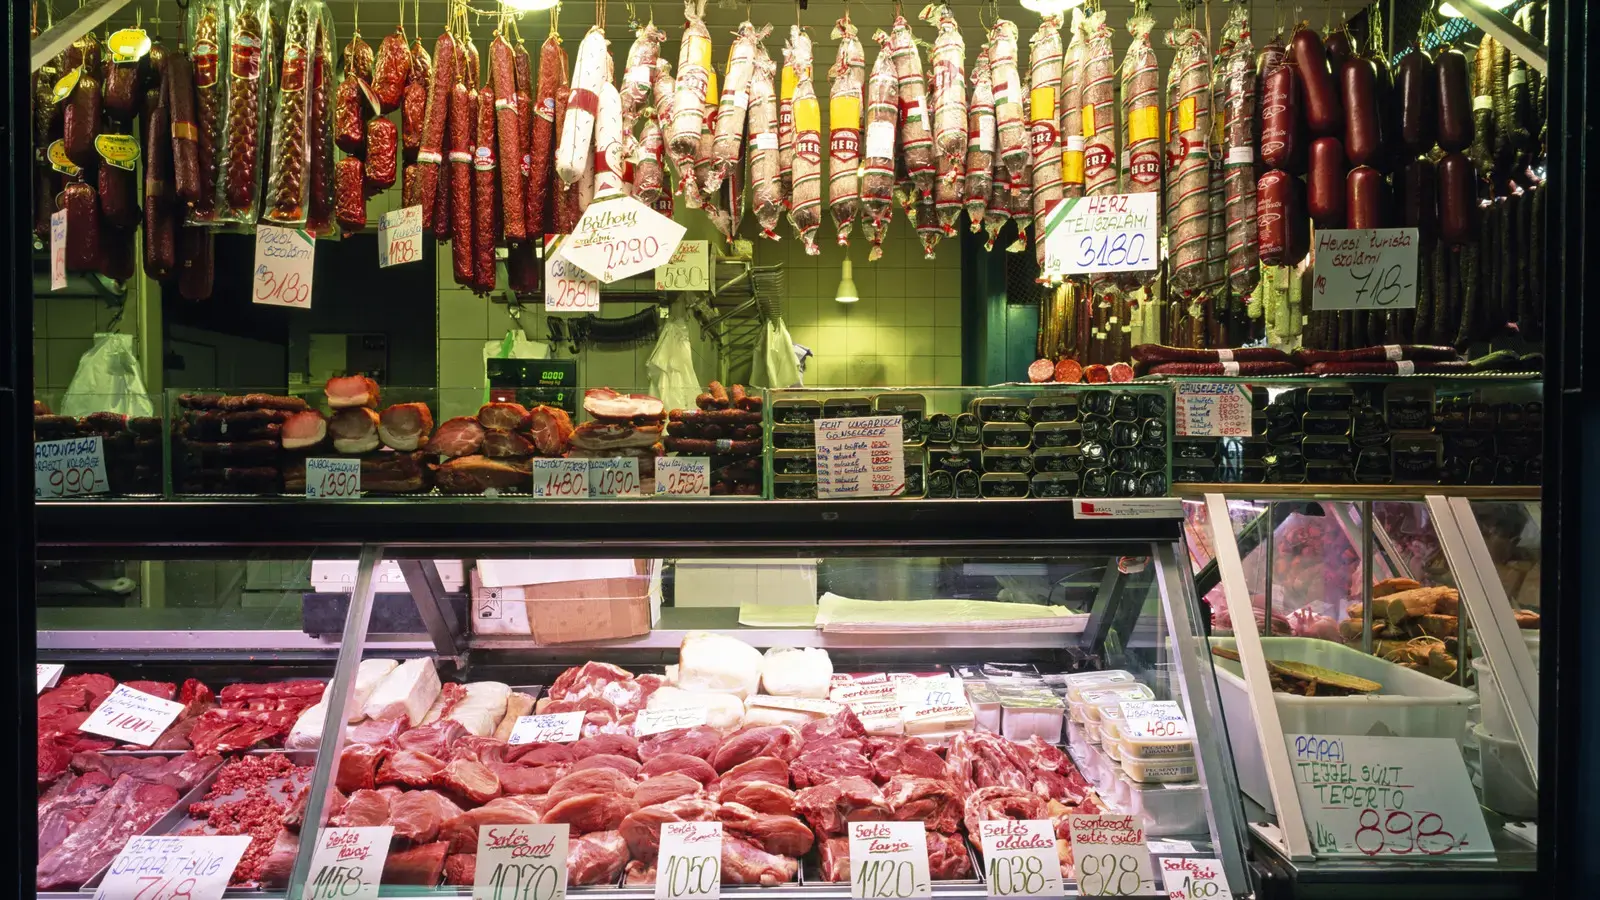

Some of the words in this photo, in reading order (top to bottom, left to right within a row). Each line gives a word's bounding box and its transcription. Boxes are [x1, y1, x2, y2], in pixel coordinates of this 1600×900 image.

[831, 139, 858, 151] HERZ
[1088, 195, 1128, 214] HERZ
[582, 210, 638, 232] Báthory
[1076, 233, 1149, 267] 3180-
[1318, 234, 1360, 252] Hevesi
[1370, 231, 1411, 248] turista
[256, 271, 309, 303] 3180
[820, 421, 843, 430] ECHT
[848, 418, 901, 429] UNGARISCH
[320, 472, 360, 497] 1390-
[545, 472, 587, 496] 1480-
[599, 470, 639, 494] 1290-
[668, 473, 708, 494] 2580-
[925, 691, 955, 706] 170-
[1147, 721, 1183, 737] 480-
[1361, 764, 1403, 786] SÜLT
[855, 823, 891, 838] Sertés
[984, 820, 1029, 835] Sertés
[1073, 815, 1133, 829] Csontozott
[485, 828, 529, 846] Sertés
[511, 835, 556, 857] comb
[996, 834, 1054, 848] oldalas
[1077, 829, 1108, 842] sertés
[665, 855, 719, 898] 1050-
[1183, 876, 1228, 899] 160-
